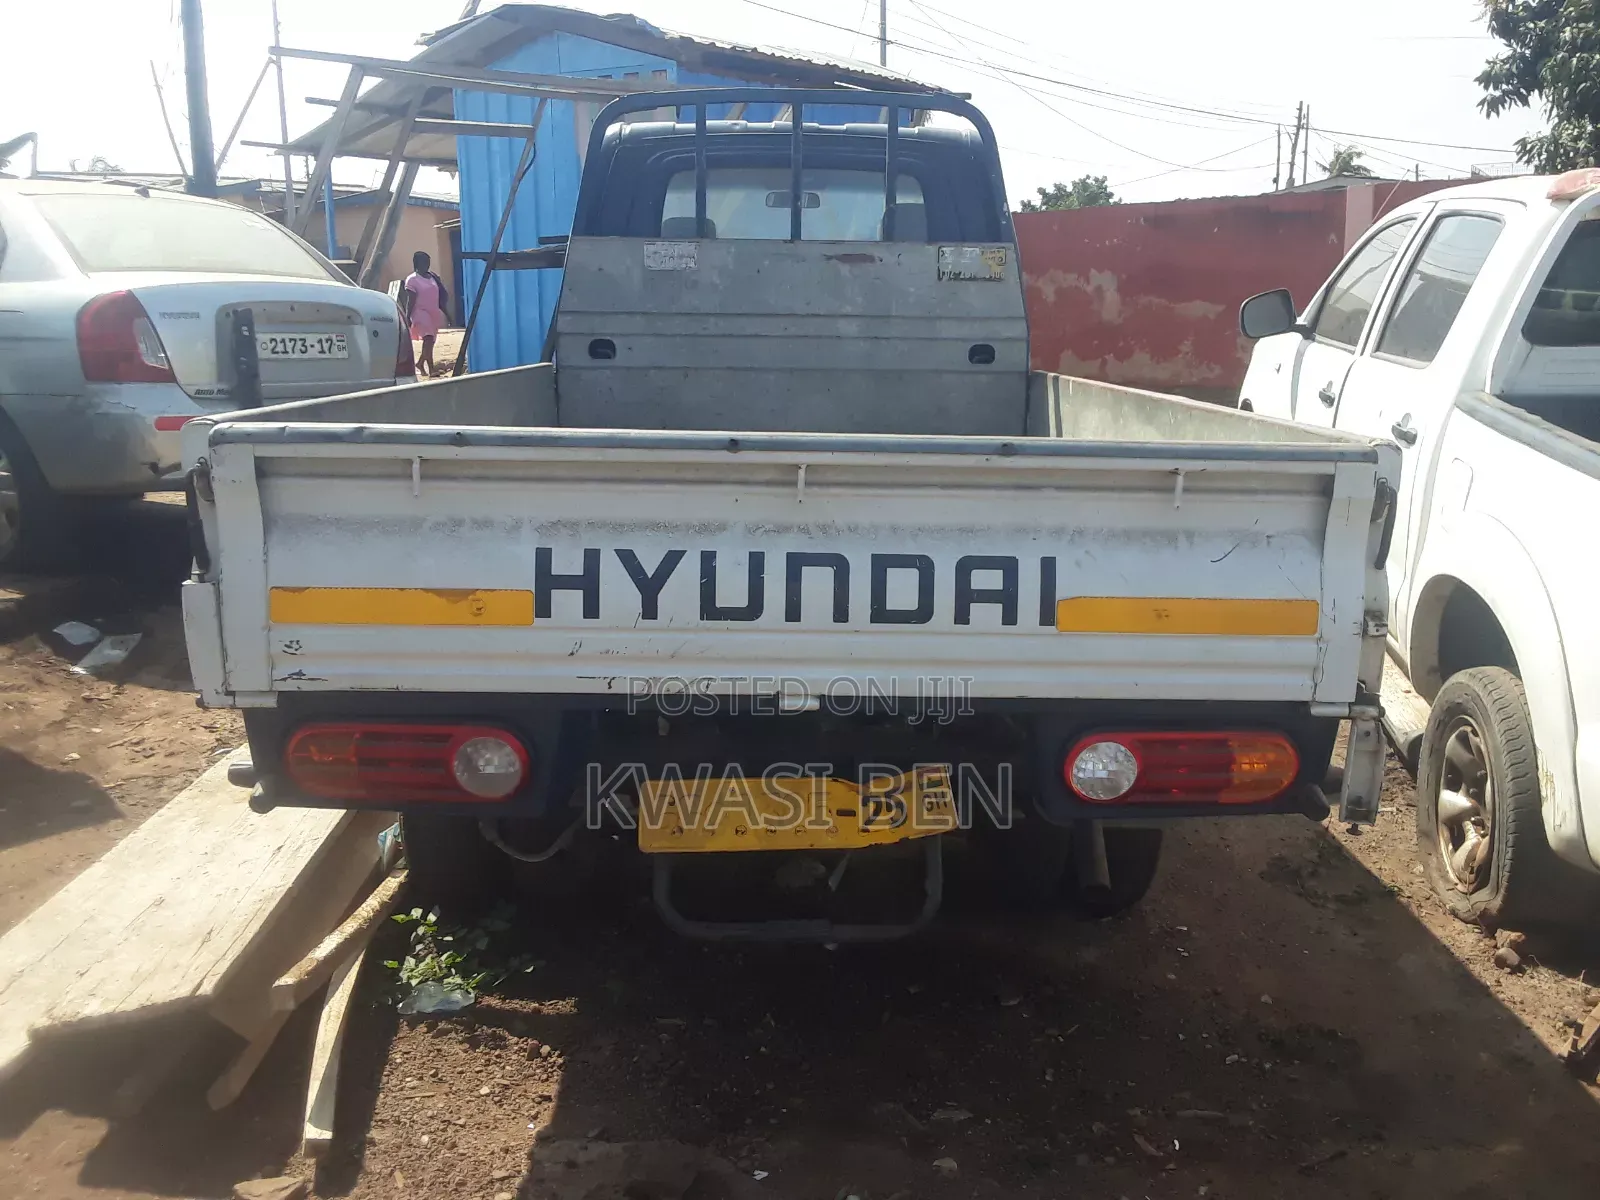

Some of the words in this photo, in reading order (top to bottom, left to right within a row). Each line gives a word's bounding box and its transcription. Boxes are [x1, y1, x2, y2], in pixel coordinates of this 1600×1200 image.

[269, 337, 334, 355] 2173-17
[336, 344, 347, 352] GH
[534, 546, 1057, 627] HYUNDAI
